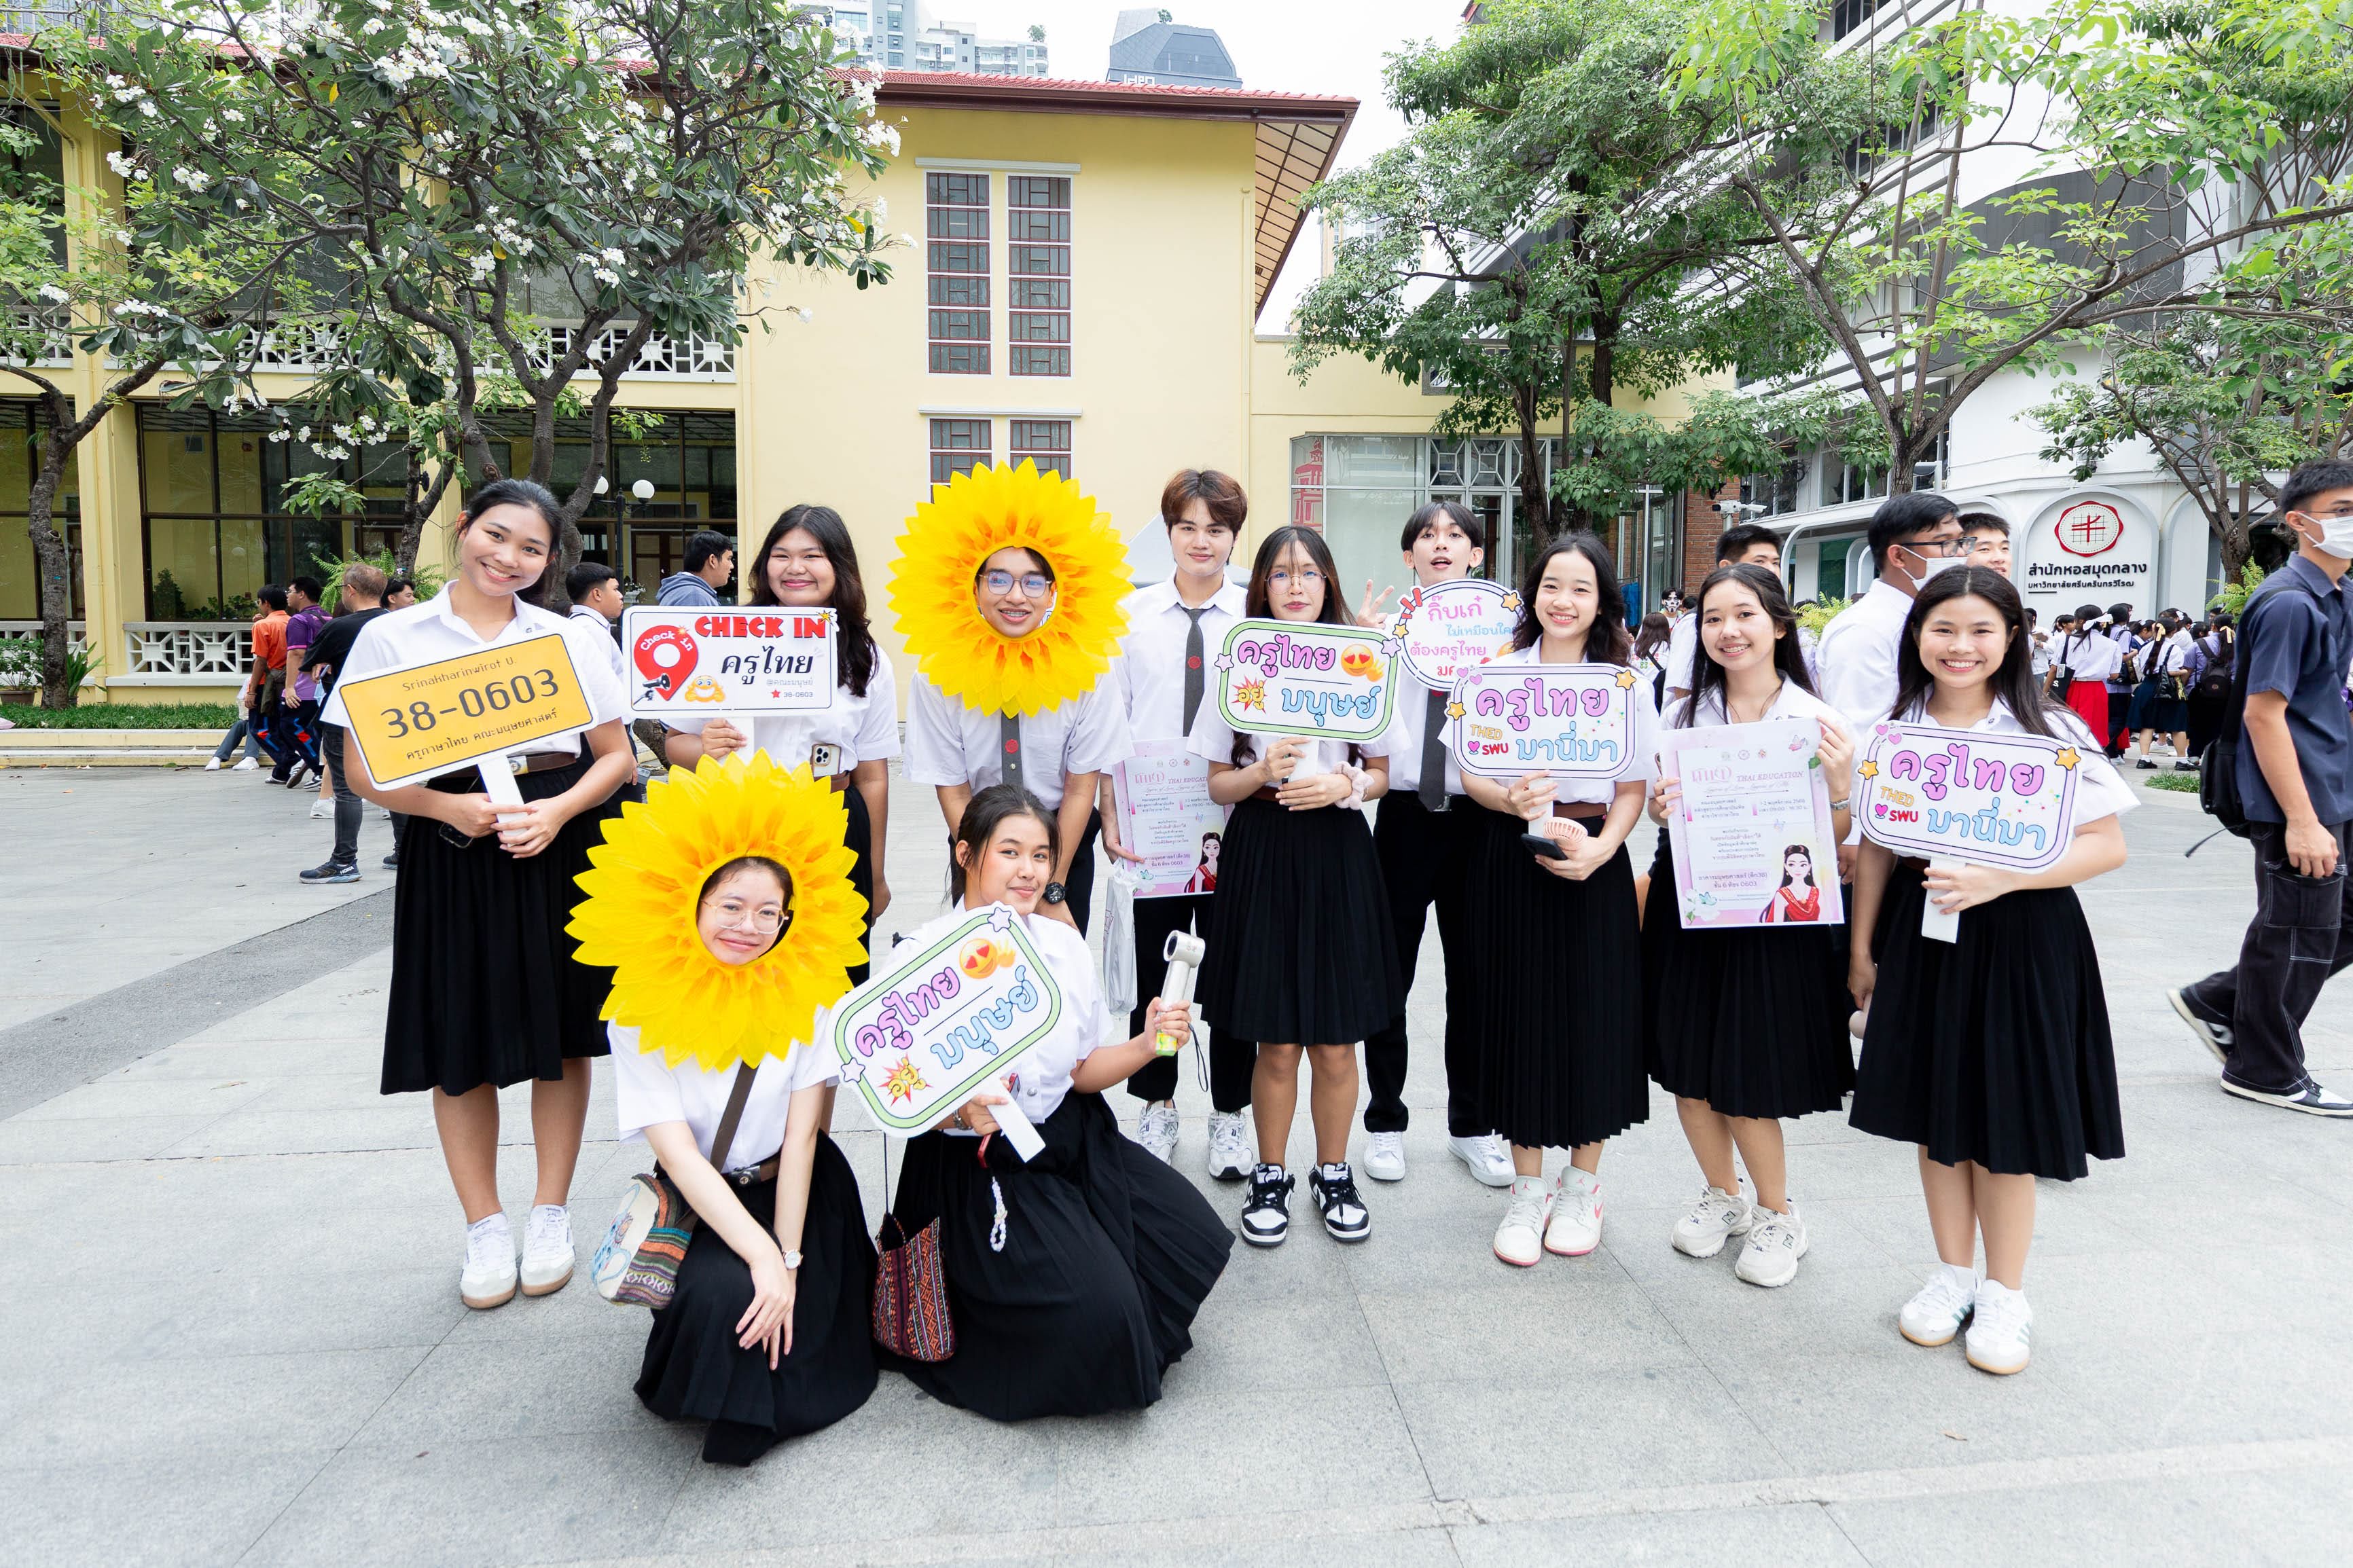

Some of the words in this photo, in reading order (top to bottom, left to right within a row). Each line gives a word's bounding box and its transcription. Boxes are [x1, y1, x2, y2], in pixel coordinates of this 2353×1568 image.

[2028, 562, 2147, 579] สำนักหอสมุดกลาง
[2028, 579, 2134, 589] มหาวิทยาลัยศรีนครินทรวิโรฒ
[1427, 595, 1483, 621] กิ๊บเก๋
[641, 630, 675, 651] Check
[680, 636, 693, 652] in
[694, 615, 784, 638] CHECK
[793, 617, 827, 638] IN
[721, 645, 814, 685] ครูไทย
[1238, 634, 1336, 678] ครูไทย
[1409, 640, 1486, 661] ต้องครูไทย
[402, 660, 501, 692] Srinakharinwirot
[380, 669, 559, 739] 38-0603
[1238, 680, 1264, 710] อยู่
[1282, 685, 1382, 727] มนุษย์
[1475, 678, 1609, 731] ครูไทย
[406, 731, 469, 761] ครูภาษาไทย
[473, 708, 558, 742] คณะมนุษยศาสตร์
[1470, 724, 1503, 740] THED
[1515, 721, 1618, 762] มานี่มา
[1481, 743, 1509, 756] SWU
[1758, 771, 1804, 780] EDUCATION
[1890, 743, 2045, 801] ครูไทย
[1880, 786, 1914, 807] THED
[1888, 809, 1919, 823] SWU
[1927, 797, 2046, 850] มานี่มา
[855, 966, 960, 1057] ครูไทย
[930, 965, 1039, 1070] มนุษย์
[887, 1057, 927, 1098] อยู่
